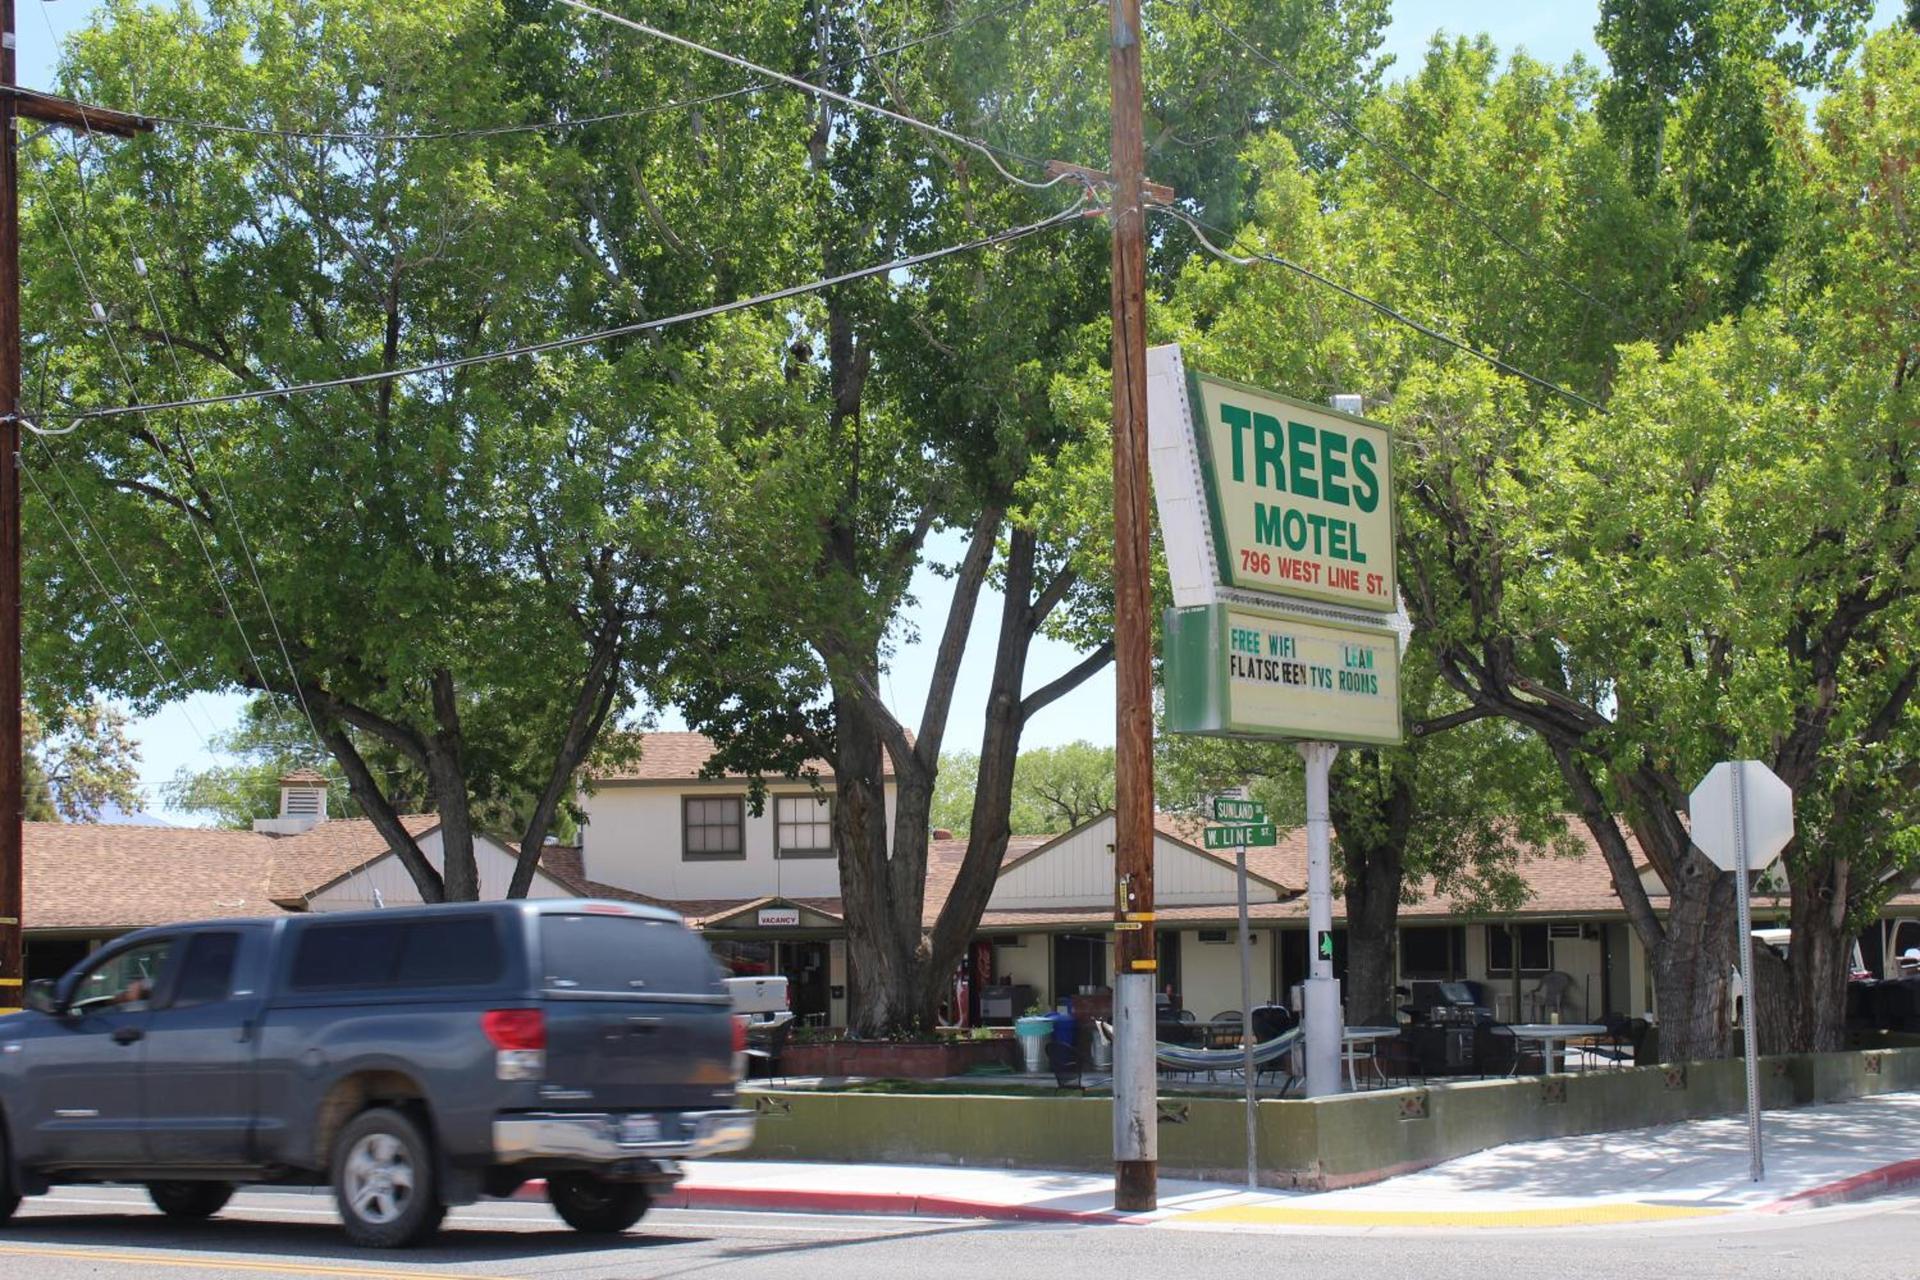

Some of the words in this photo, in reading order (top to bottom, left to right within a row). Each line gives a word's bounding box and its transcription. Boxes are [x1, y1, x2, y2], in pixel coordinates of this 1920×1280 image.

[1220, 403, 1379, 513] TREES
[1254, 502, 1367, 564] MOTEL
[1240, 549, 1271, 575] 796
[1278, 557, 1321, 584] WEST
[1328, 566, 1359, 591] LINE
[1366, 573, 1388, 596] ST.
[1231, 628, 1260, 654] FREE
[1268, 634, 1296, 658] WIFI
[1310, 666, 1332, 689] TVS
[1339, 670, 1378, 695] ROOMS
[1218, 802, 1254, 819] SUNLAND
[1223, 828, 1254, 845] LINE
